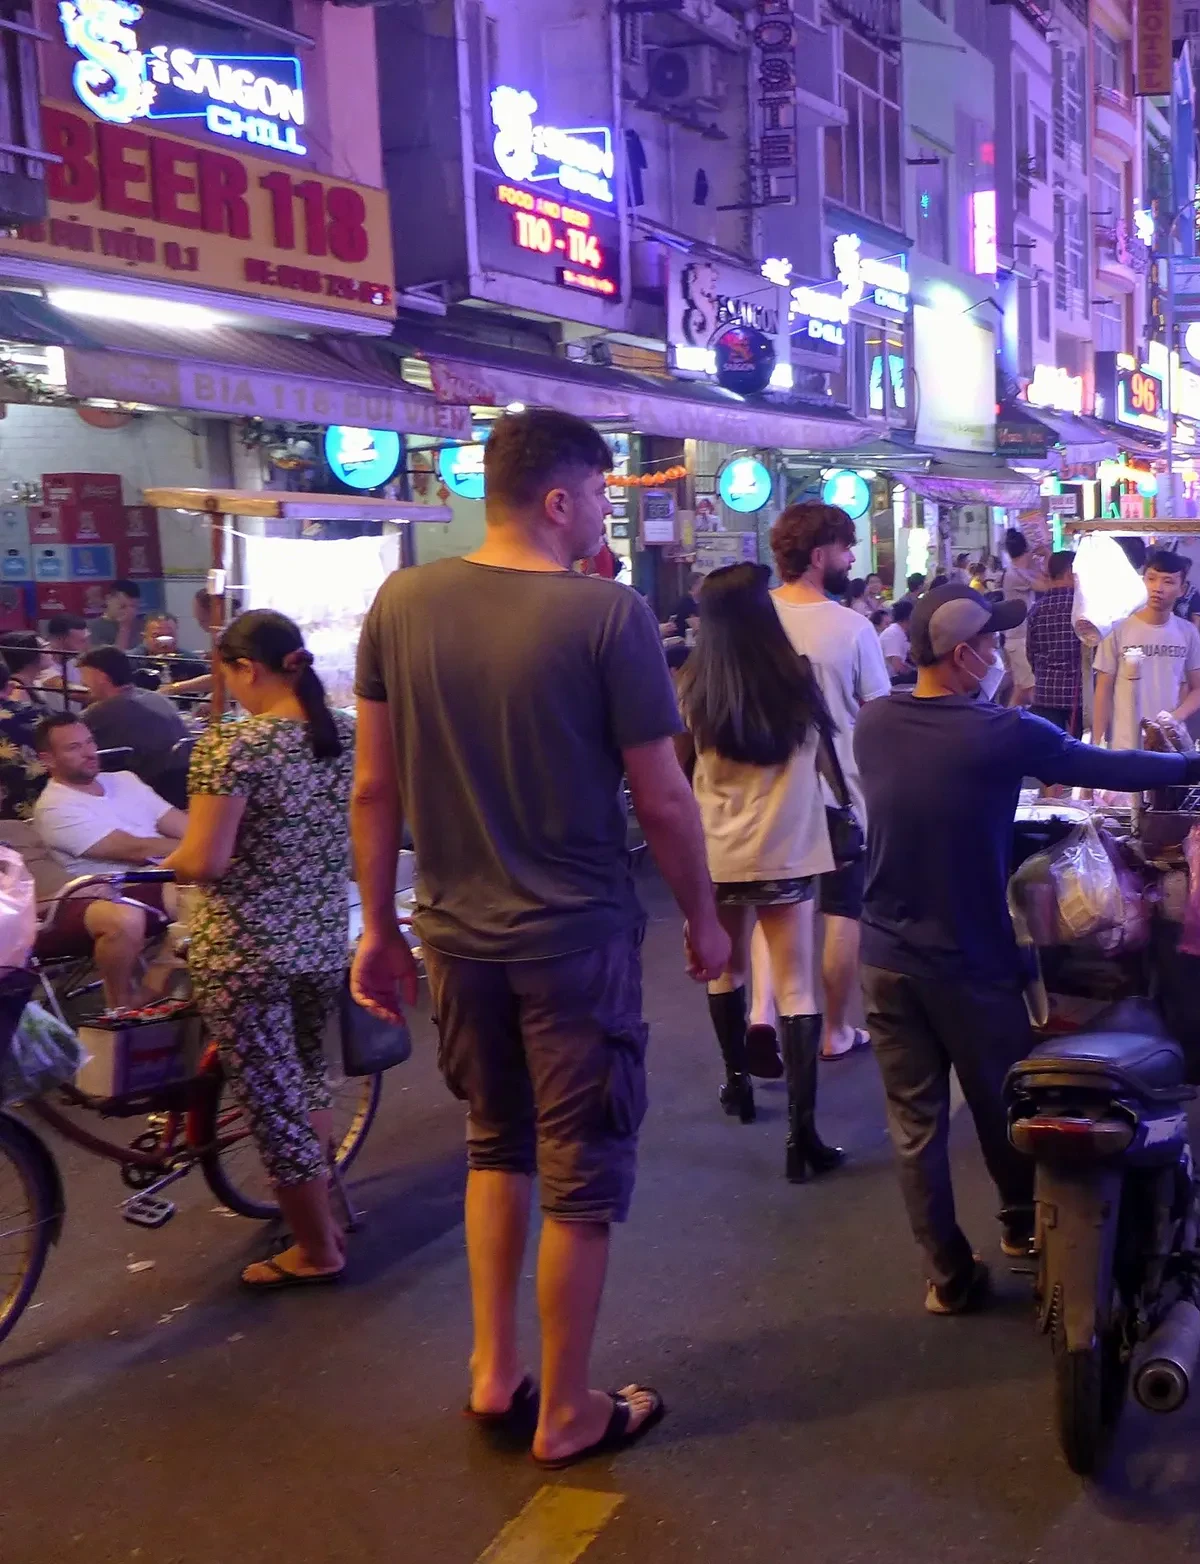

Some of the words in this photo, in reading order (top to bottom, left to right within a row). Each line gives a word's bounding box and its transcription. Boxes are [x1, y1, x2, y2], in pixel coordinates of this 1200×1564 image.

[170, 48, 305, 126] SAIGON
[206, 104, 307, 156] CHILL
[41, 106, 251, 241] BEER
[259, 170, 369, 263] 118
[194, 372, 256, 408] BIA
[1131, 373, 1156, 412] 96
